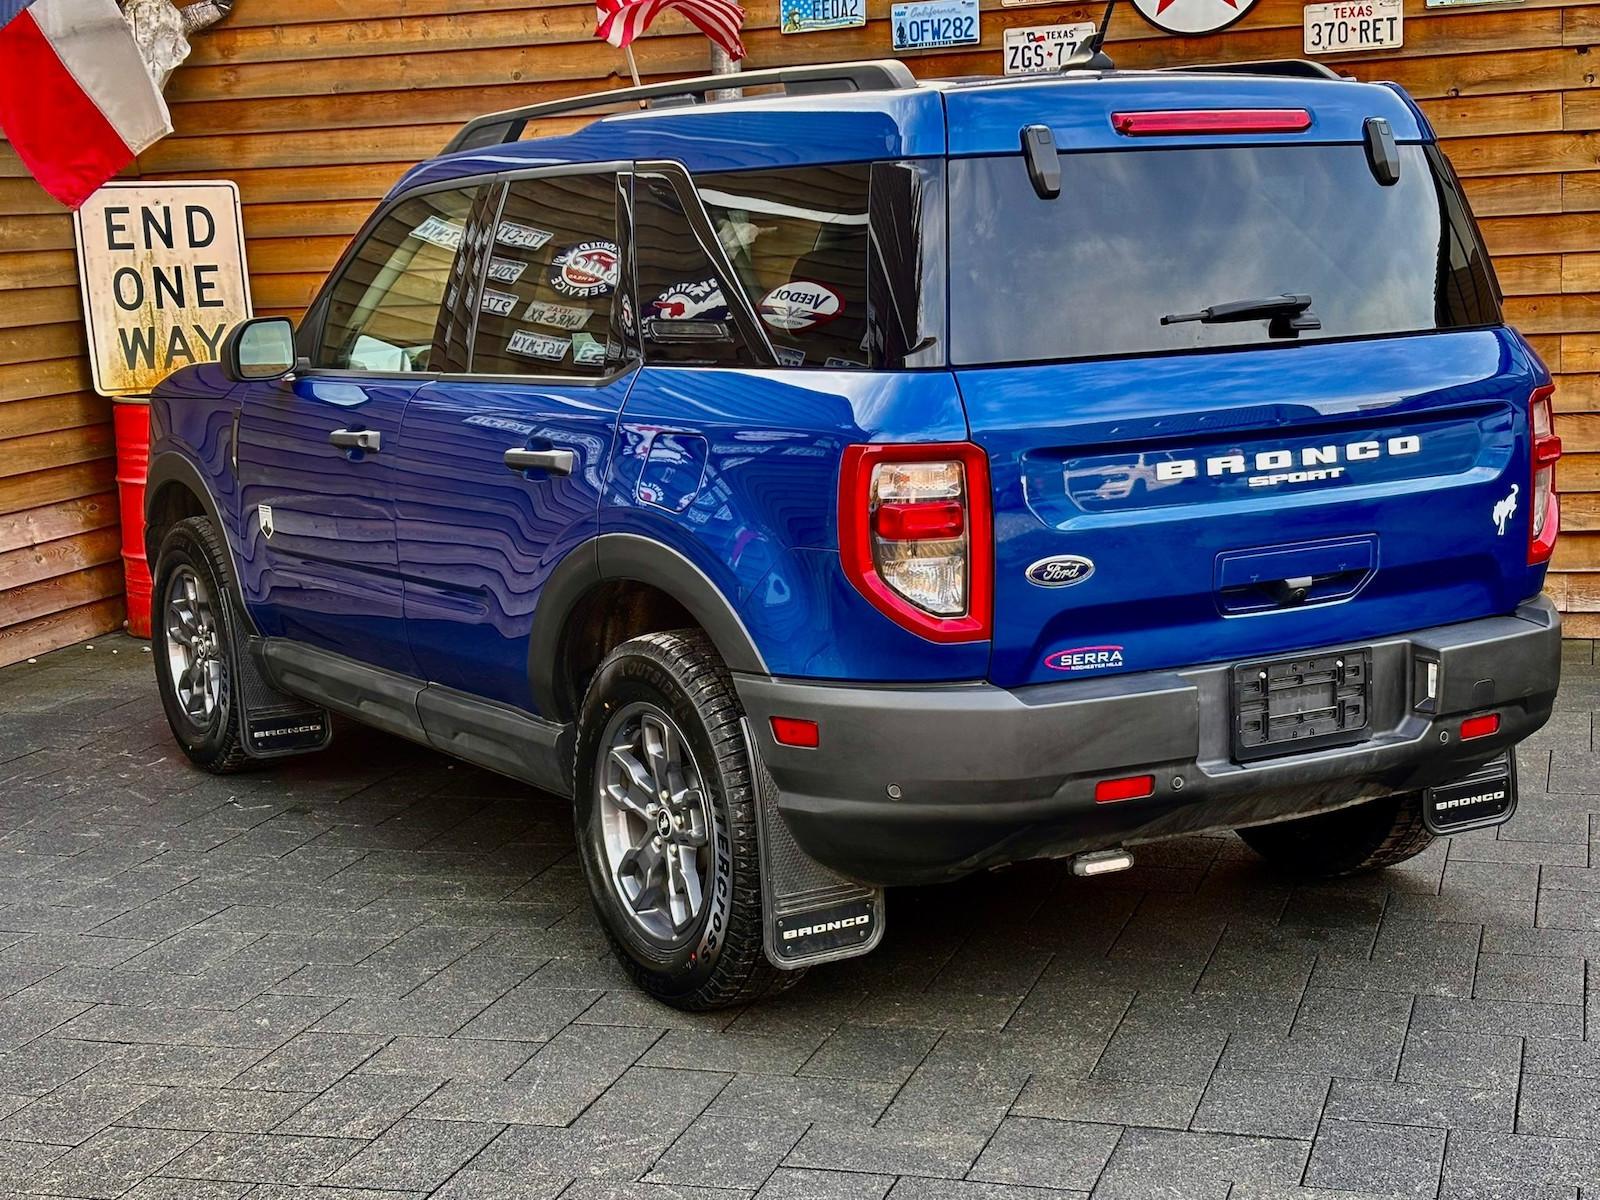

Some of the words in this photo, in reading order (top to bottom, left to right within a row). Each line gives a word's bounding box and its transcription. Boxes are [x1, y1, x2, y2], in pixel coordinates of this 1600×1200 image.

[1333, 5, 1373, 19] TEXAS
[1046, 30, 1074, 40] TEXAS
[1311, 21, 1348, 46] 370
[1359, 17, 1397, 43] RET
[1009, 45, 1044, 69] ZGS
[1054, 41, 1079, 65] 77
[104, 205, 215, 250] END
[113, 264, 224, 311] ONE
[118, 323, 226, 371] WAY
[1156, 435, 1421, 481] BRONCO
[1248, 466, 1345, 487] SPORT
[1043, 561, 1085, 580] Ford
[1060, 650, 1123, 666] SERRA
[253, 725, 321, 738] BRONCO
[1435, 790, 1505, 811] BRONCO
[783, 915, 870, 940] BRONCO
